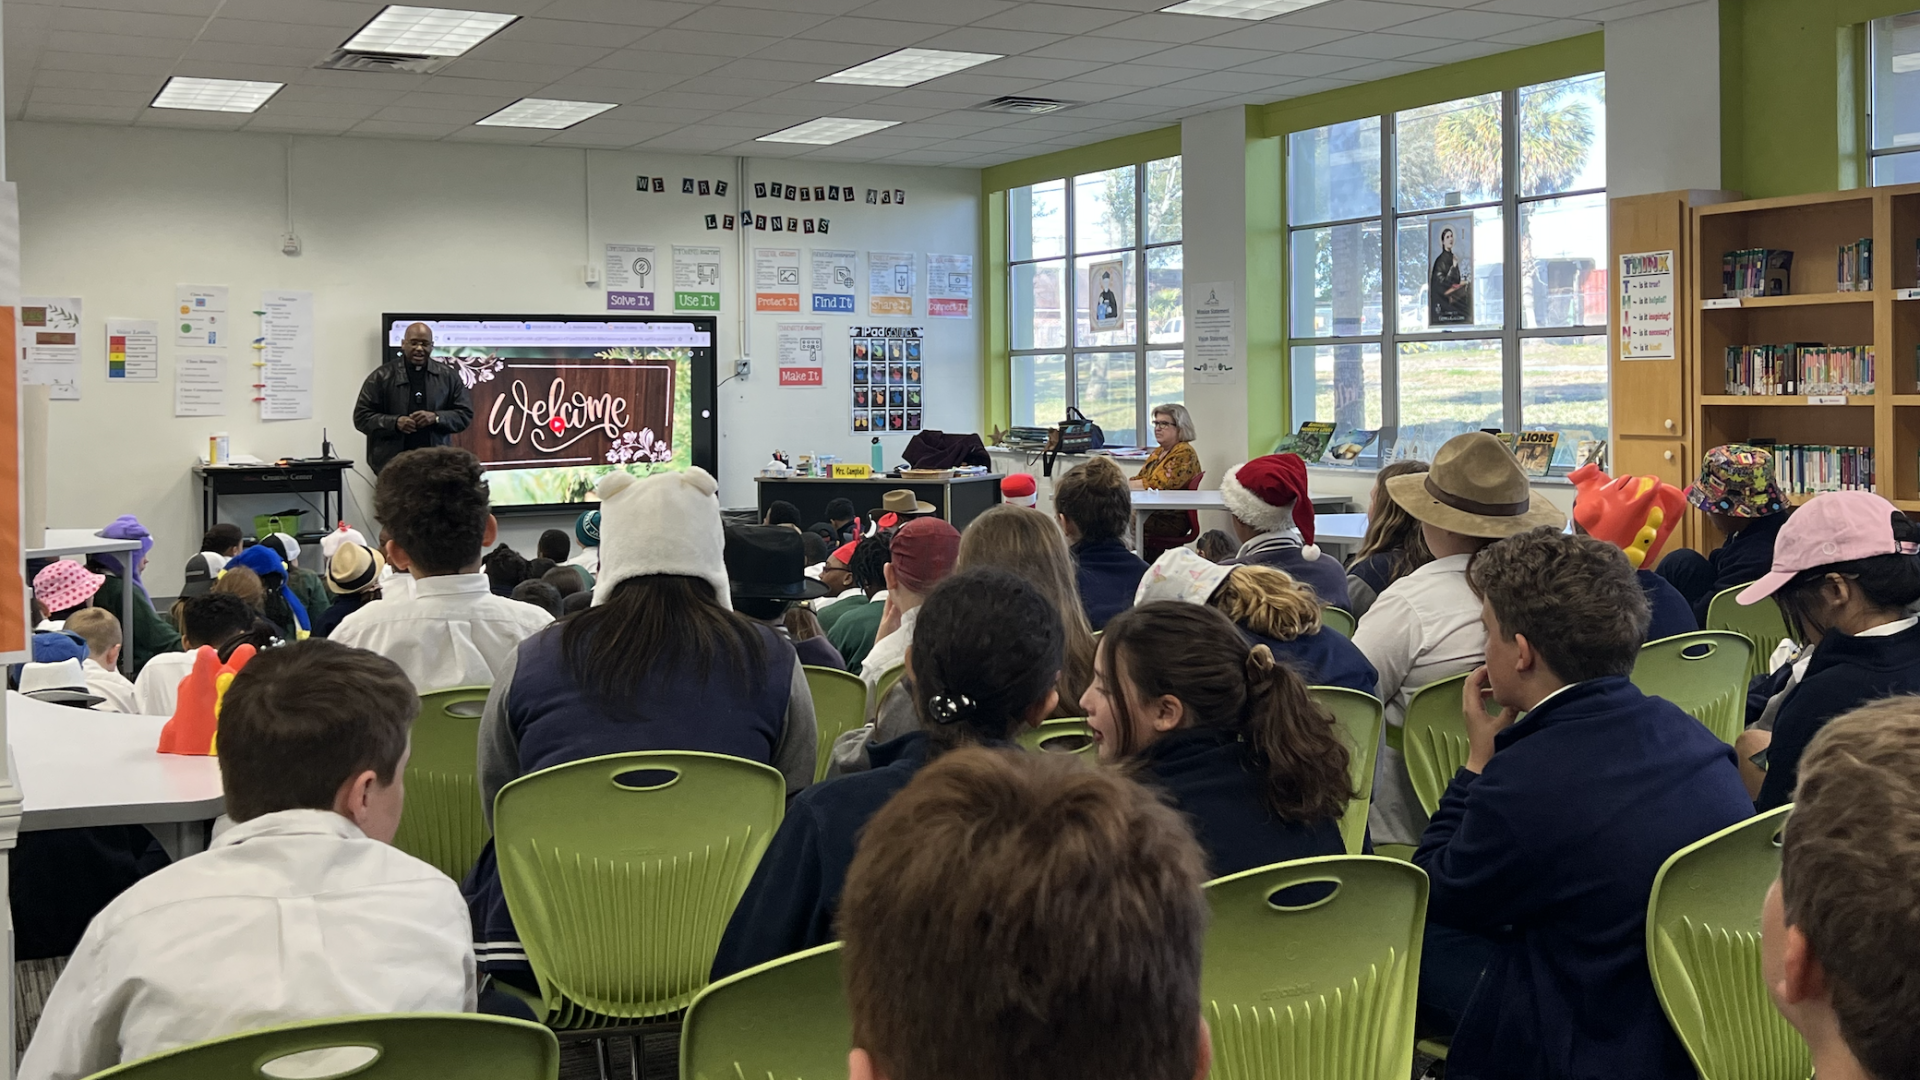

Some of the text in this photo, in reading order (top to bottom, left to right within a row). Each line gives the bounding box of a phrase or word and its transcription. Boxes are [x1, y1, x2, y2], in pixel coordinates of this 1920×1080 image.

[637, 177, 905, 204] WE ARE DIGITAL AGE
[706, 211, 829, 233] LEARNERS
[1623, 255, 1669, 275] THINK
[1622, 280, 1630, 293] T
[611, 295, 650, 306] Solve It
[679, 294, 716, 307] Use It
[757, 297, 798, 306] Protect It
[814, 296, 853, 309] Find It
[871, 299, 911, 310] Share It
[1622, 295, 1631, 309] H
[928, 302, 967, 313] Connect It
[861, 326, 884, 337] iPad
[1622, 326, 1631, 339] N
[1622, 341, 1632, 355] K
[782, 371, 820, 381] Make It
[488, 377, 630, 452] Welcome
[1521, 433, 1554, 443] LIONS
